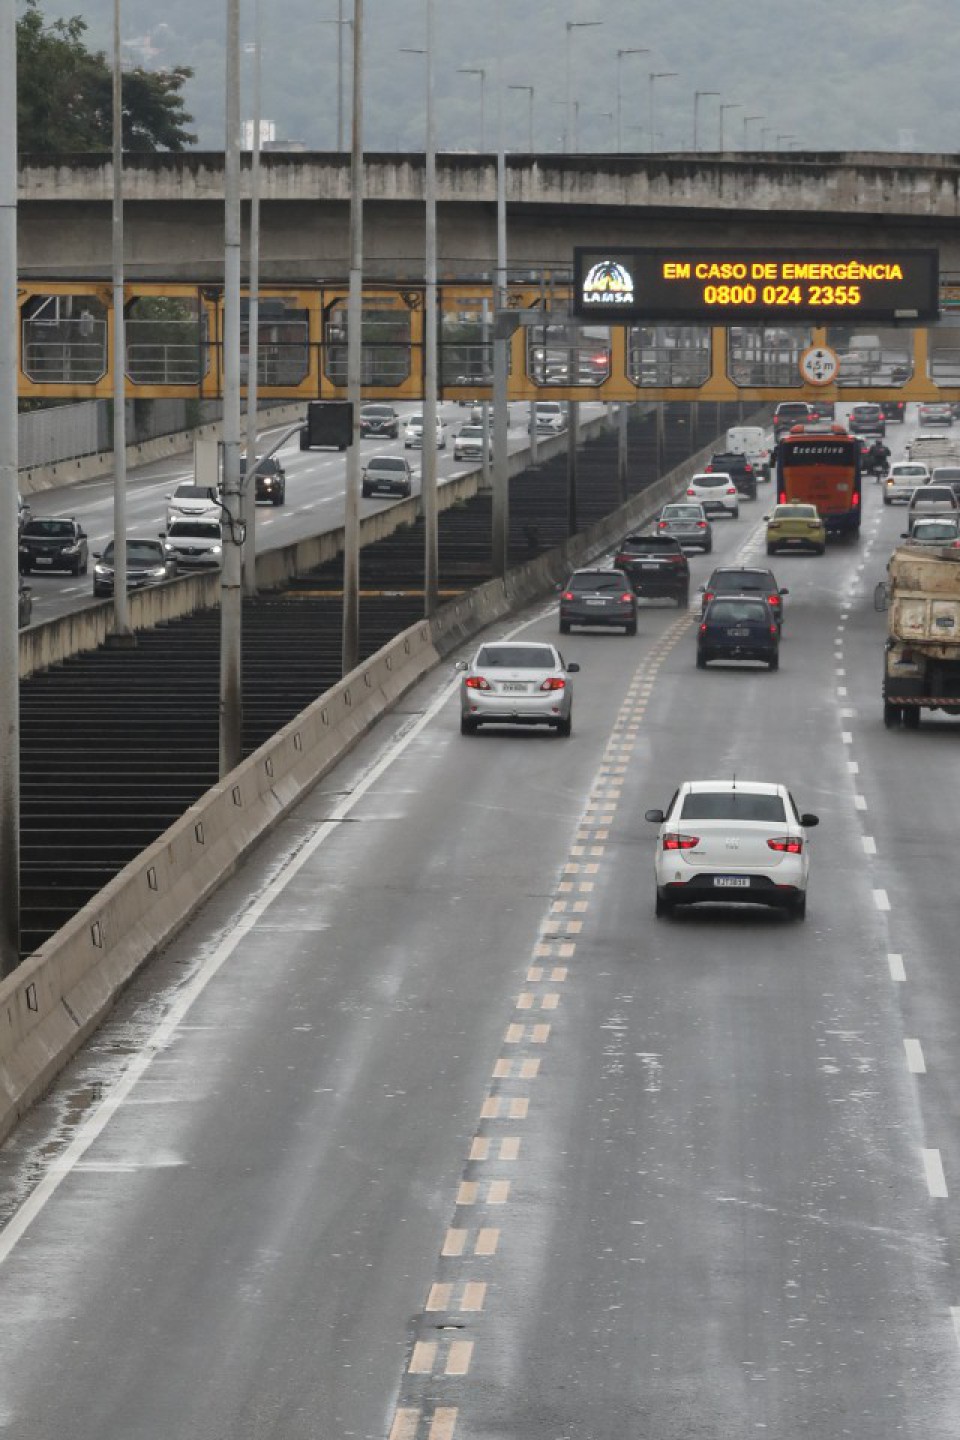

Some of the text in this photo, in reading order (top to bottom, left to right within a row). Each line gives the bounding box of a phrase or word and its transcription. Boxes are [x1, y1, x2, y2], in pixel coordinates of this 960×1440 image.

[663, 260, 903, 280] EM CASO DE EMERGÊNCIA
[583, 292, 634, 303] LAMSA
[704, 285, 861, 305] 0800 024 2355
